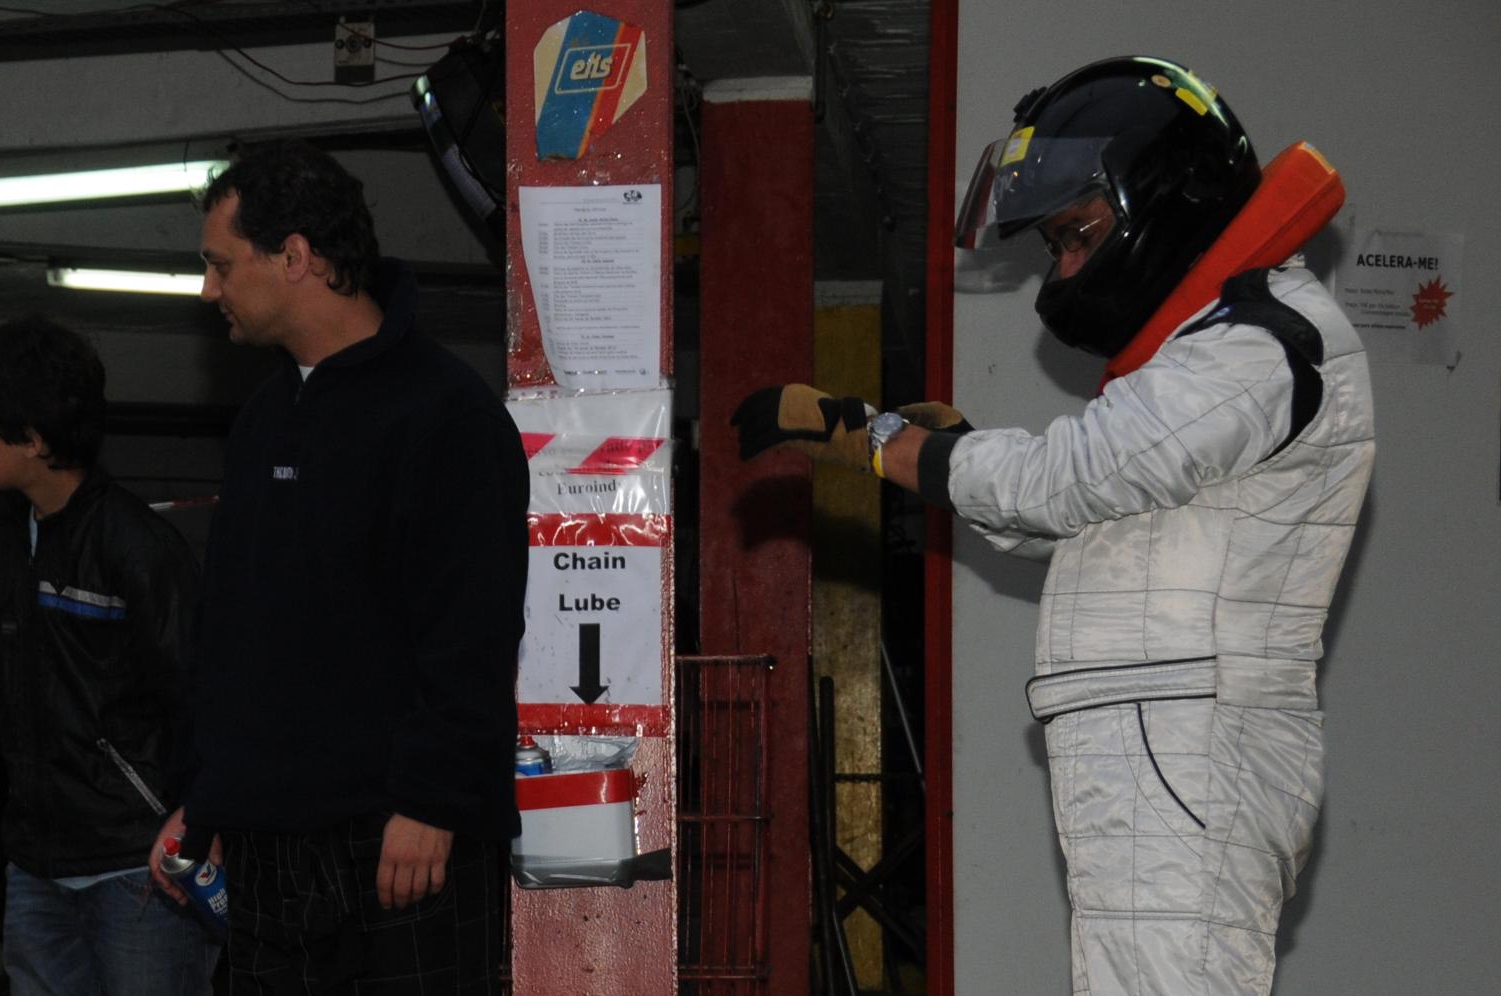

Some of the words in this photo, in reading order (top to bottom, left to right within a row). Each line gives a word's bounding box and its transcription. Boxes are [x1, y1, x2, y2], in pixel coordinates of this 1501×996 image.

[1356, 254, 1439, 271] ACELERA-ME!
[557, 479, 621, 496] Euroind
[553, 552, 626, 570] Chain
[558, 594, 621, 612] Lube
